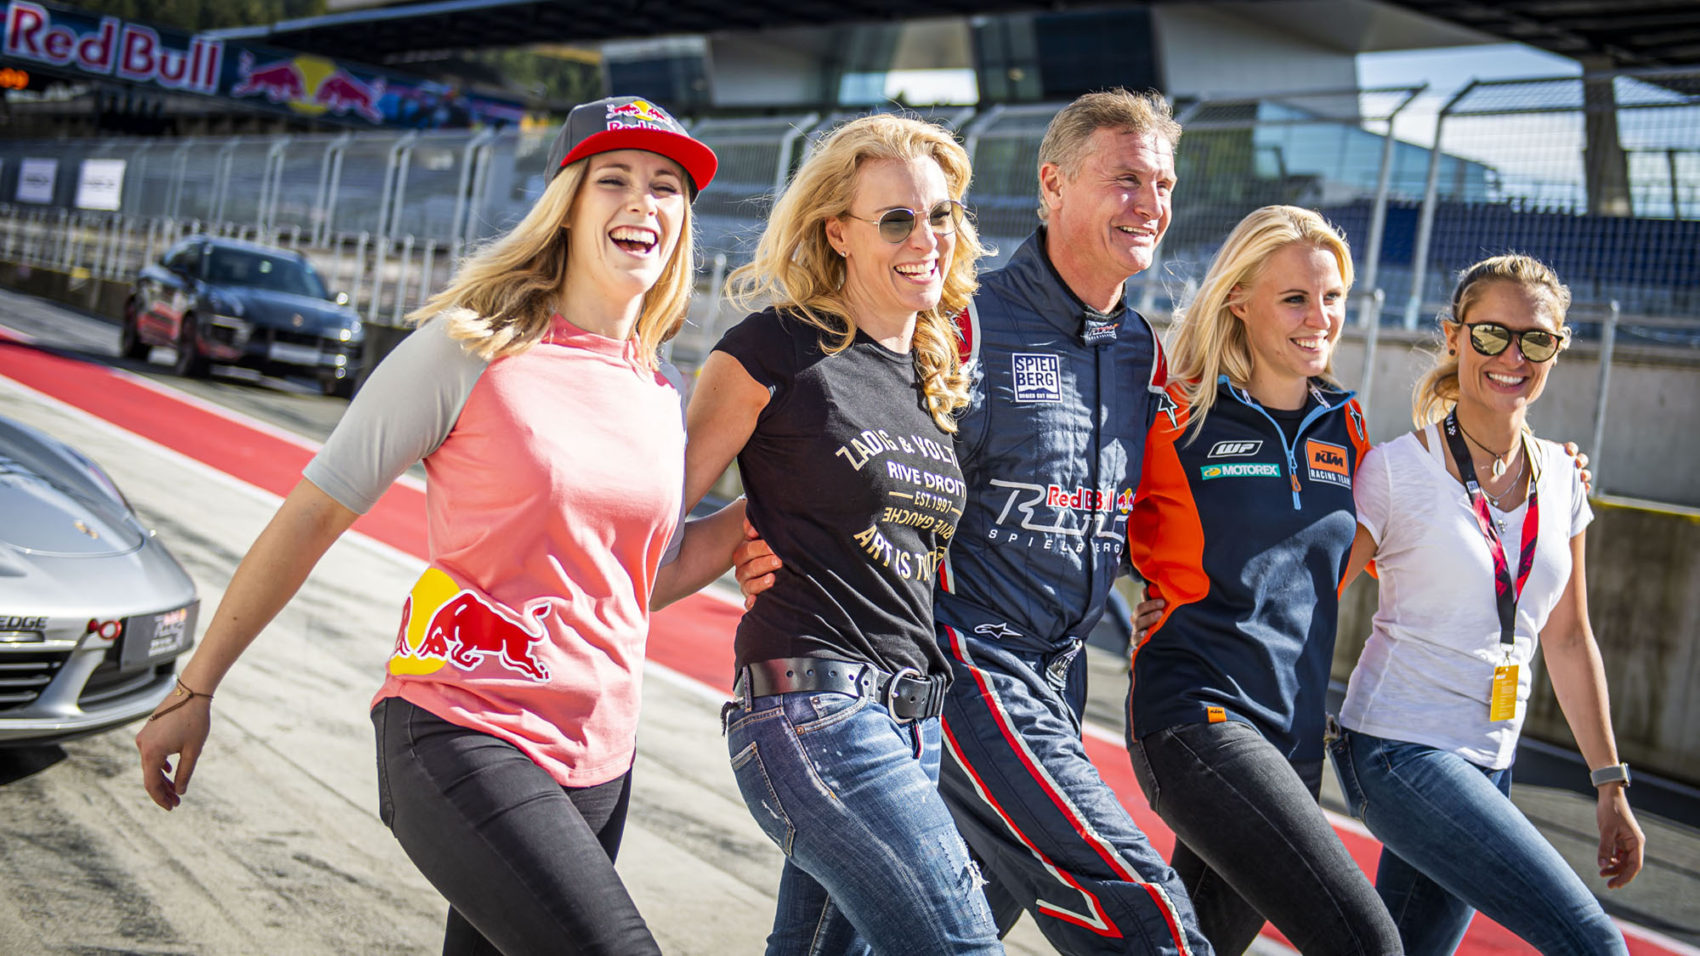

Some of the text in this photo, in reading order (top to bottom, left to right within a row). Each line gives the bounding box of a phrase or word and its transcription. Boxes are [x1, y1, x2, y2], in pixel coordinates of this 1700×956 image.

[4, 1, 223, 95] Red Bull
[1015, 357, 1058, 371] SPIEL
[1016, 372, 1055, 386] BERG
[835, 429, 899, 471] ZADIG
[898, 436, 915, 454] &
[1216, 444, 1255, 455] WP
[1315, 451, 1344, 467] KTM
[887, 460, 967, 498] RIVE DROIT
[1222, 466, 1278, 476] MOTOREX
[1311, 469, 1351, 486] RACING TEAM
[1046, 484, 1083, 510] Red
[882, 507, 935, 529] GAUCHE
[853, 524, 893, 567] ART
[895, 548, 912, 579] IS
[988, 529, 1120, 554] SPIELBERG
